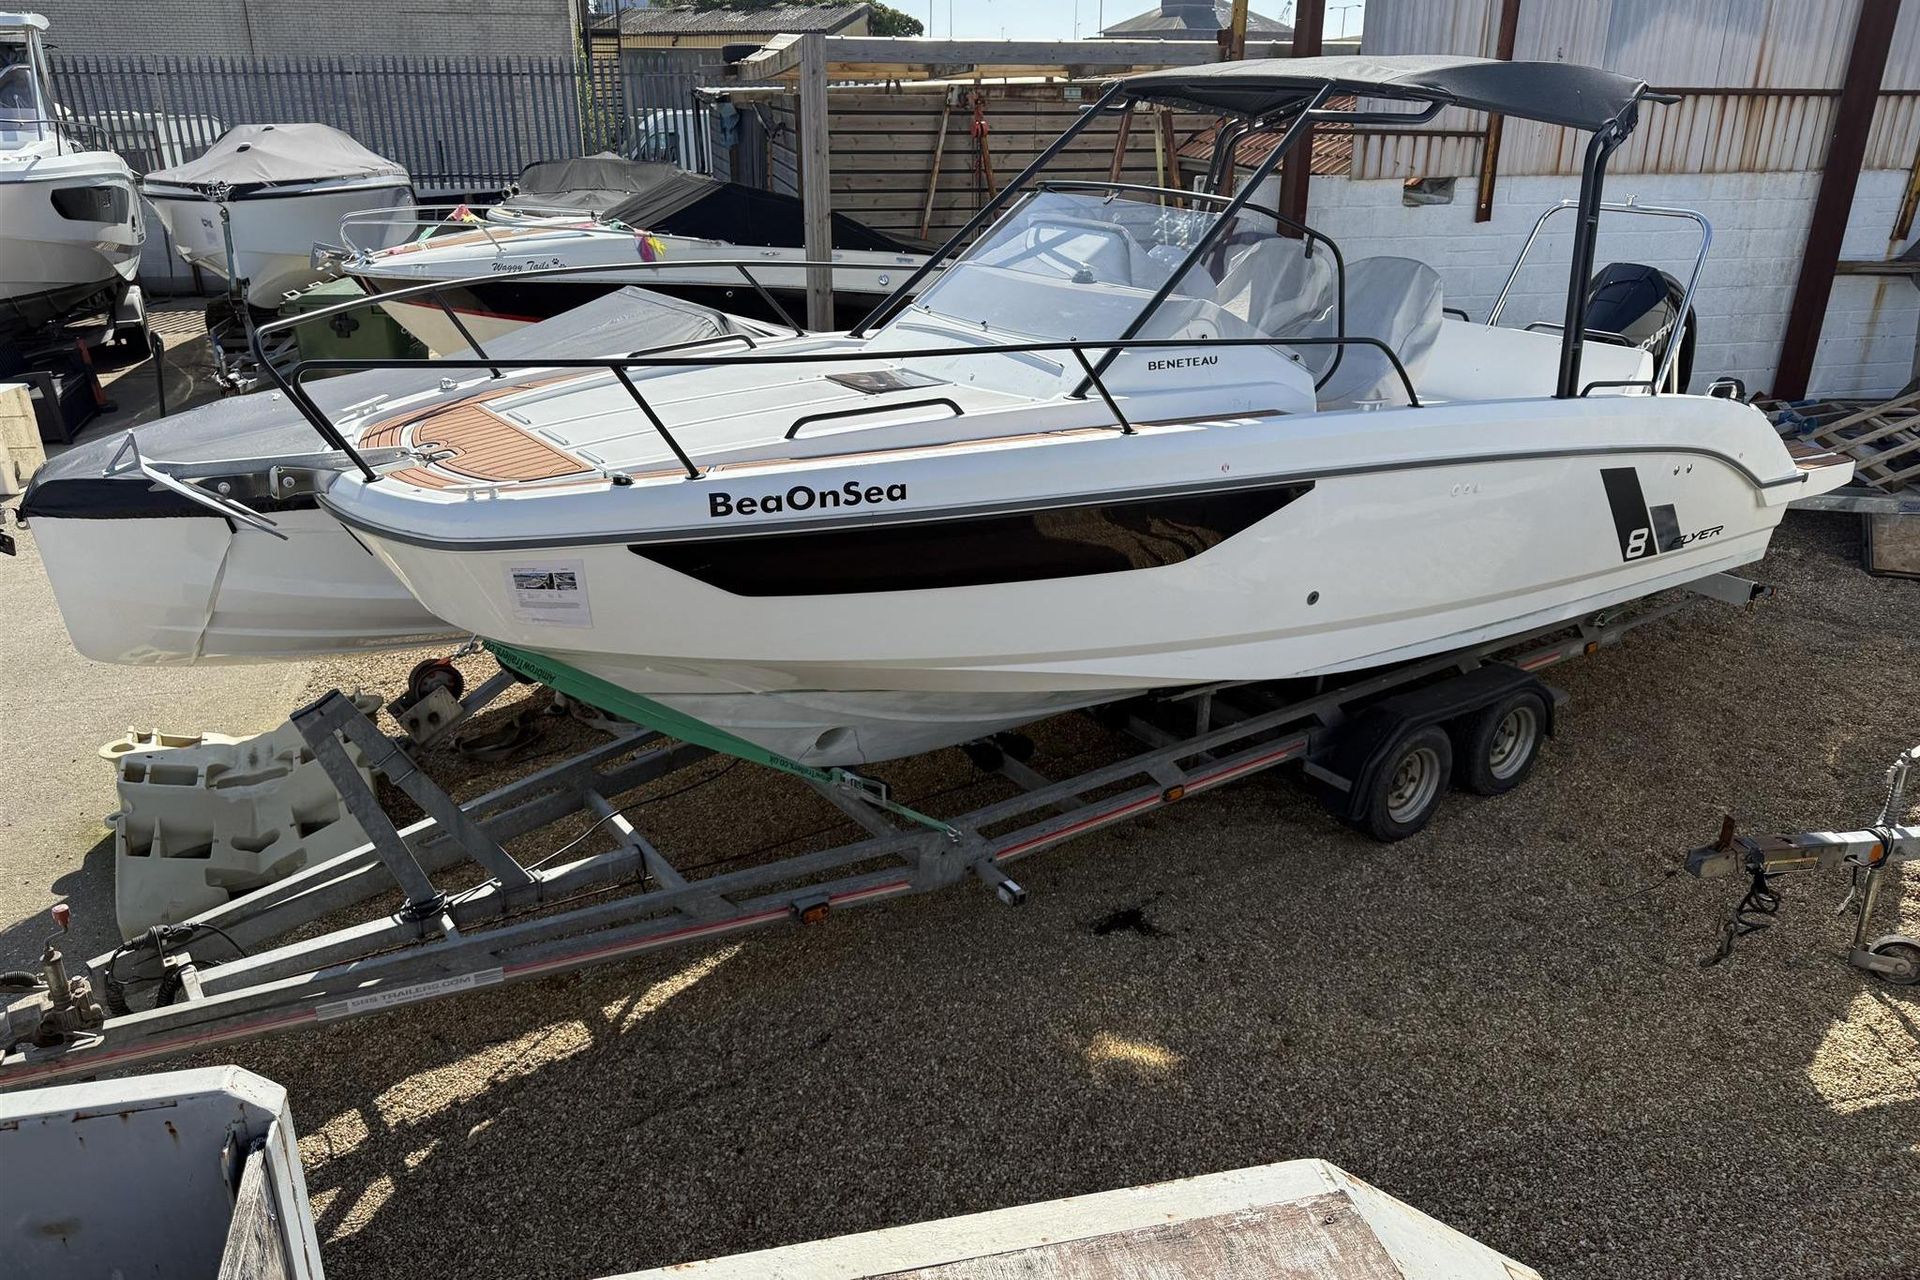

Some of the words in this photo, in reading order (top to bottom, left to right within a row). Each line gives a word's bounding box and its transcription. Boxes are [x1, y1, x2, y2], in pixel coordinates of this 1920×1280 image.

[492, 262, 523, 273] Waggy
[527, 260, 550, 270] Tails
[1636, 317, 1675, 350] CURY
[1148, 355, 1218, 371] BENETEAU
[708, 481, 907, 517] BeaOnSea
[1626, 527, 1649, 559] 8
